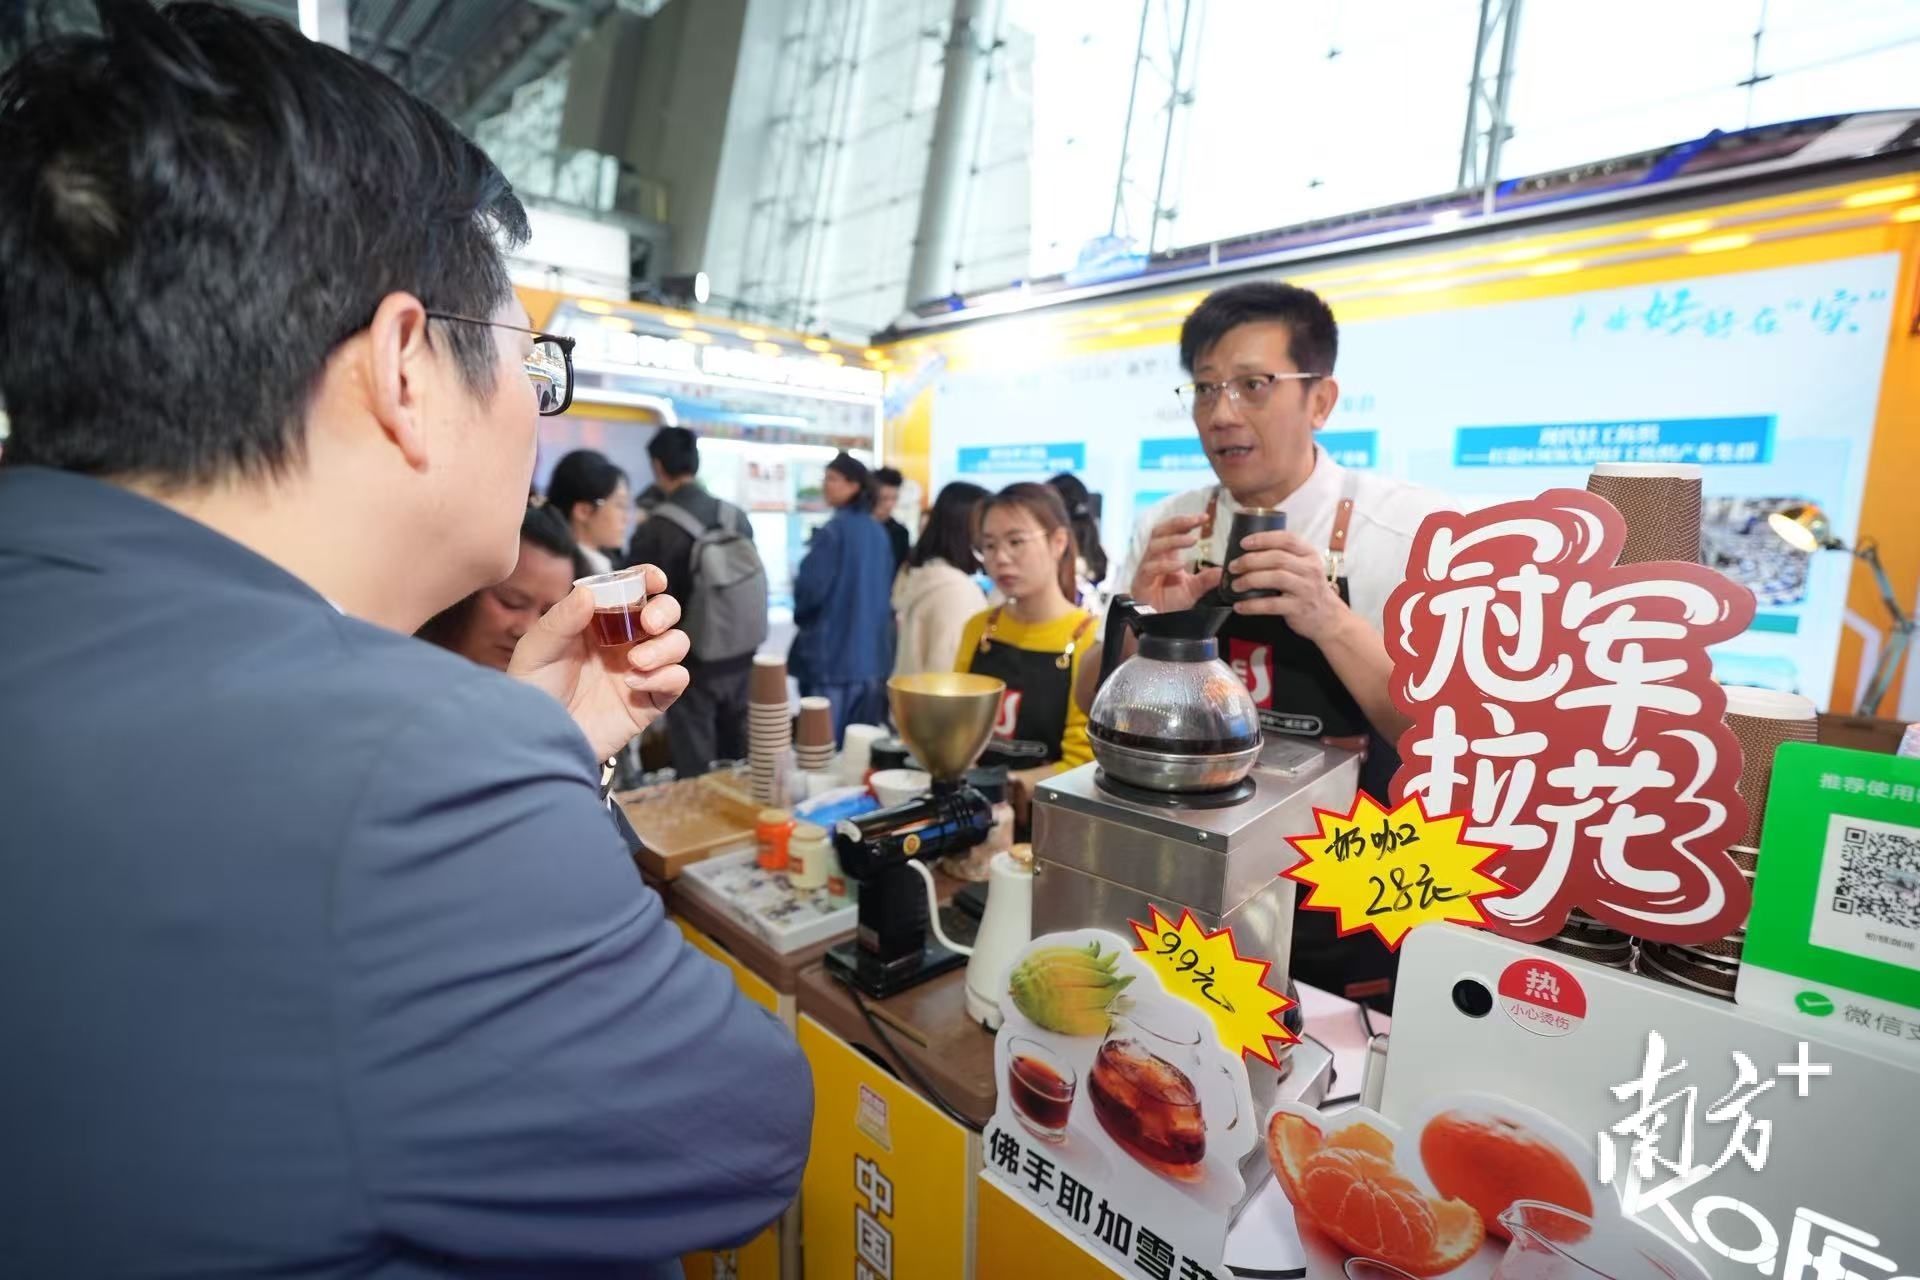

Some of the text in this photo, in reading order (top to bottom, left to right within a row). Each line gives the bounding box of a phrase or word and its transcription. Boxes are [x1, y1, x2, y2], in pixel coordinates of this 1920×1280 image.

[1407, 517, 1720, 751] 冠军
[1404, 703, 1681, 915] 拉花
[1819, 772, 1920, 803] 推荐使用
[1324, 818, 1420, 862] 奶咖
[1365, 863, 1472, 916] 28元
[1156, 931, 1236, 1014] 9.9元
[1525, 967, 1561, 1004] 热
[1510, 1003, 1570, 1030] 小心烫伤
